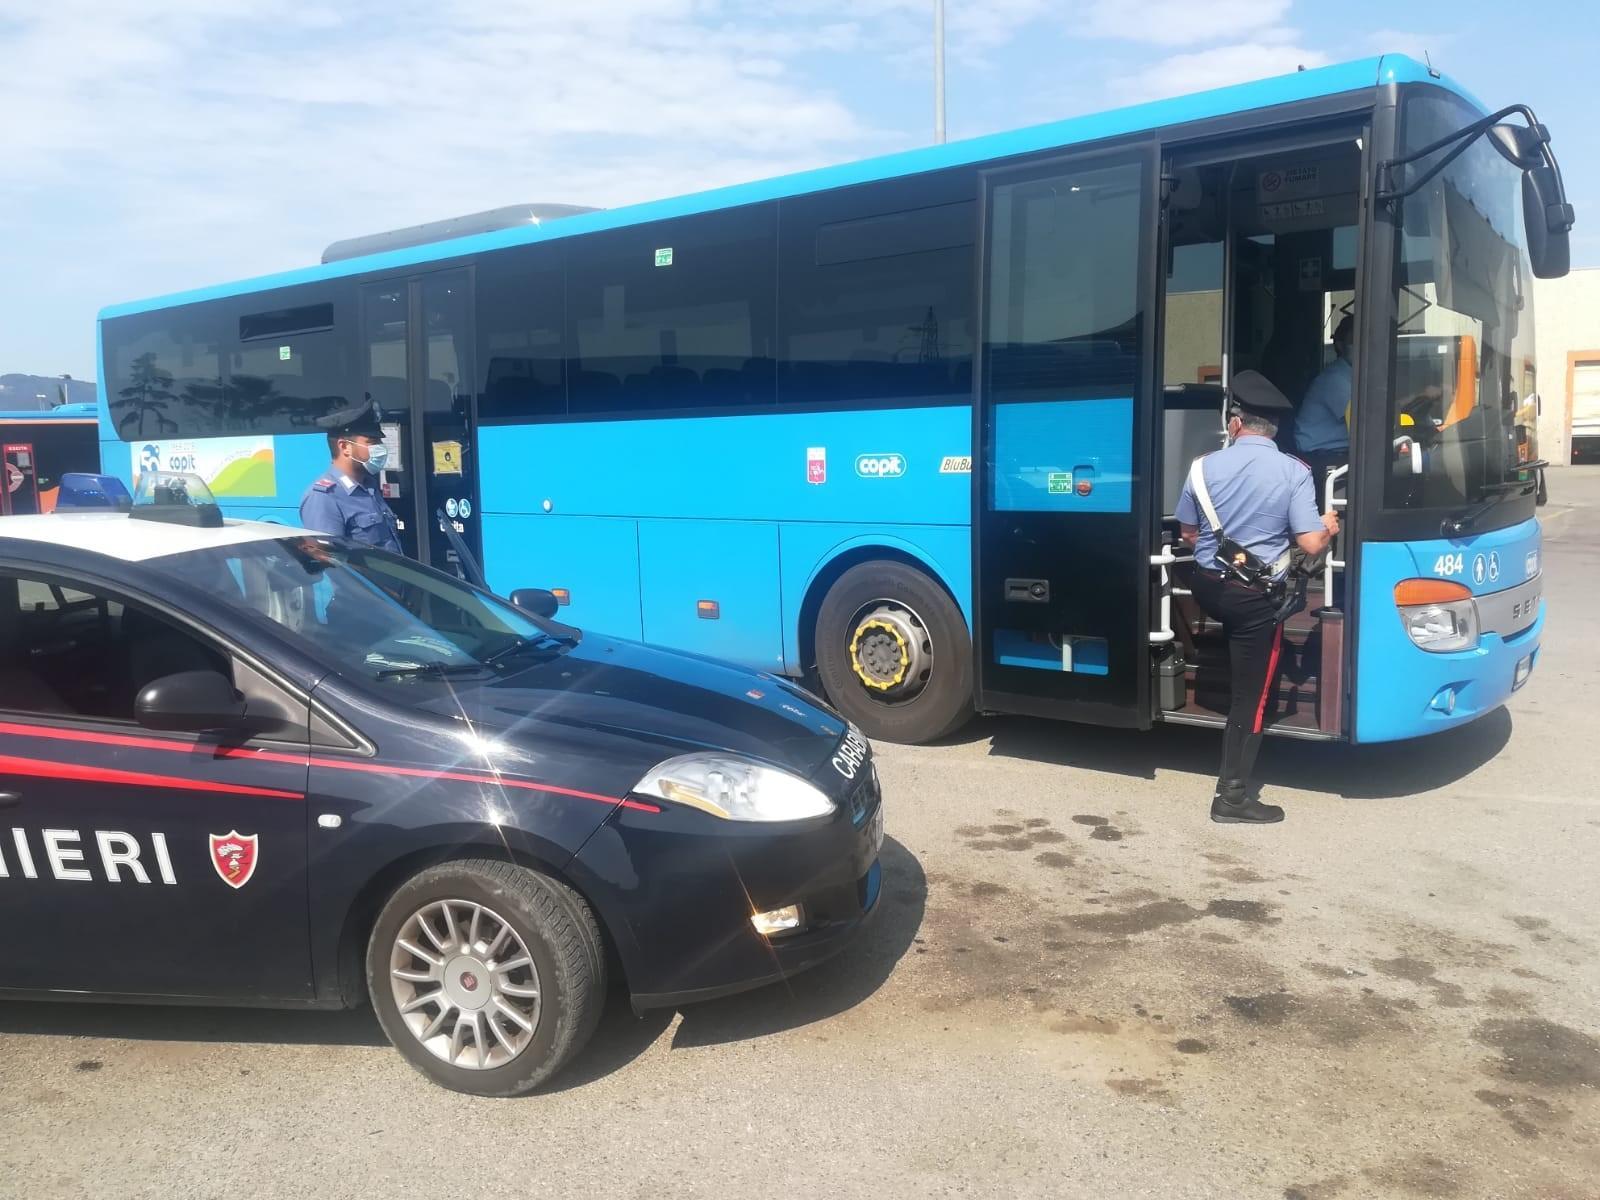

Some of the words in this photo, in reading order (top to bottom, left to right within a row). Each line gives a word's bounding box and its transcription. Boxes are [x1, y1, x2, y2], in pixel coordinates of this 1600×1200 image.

[859, 456, 902, 477] copit
[943, 458, 972, 471] BluBu
[1434, 553, 1464, 577] 484
[0, 827, 178, 885] IERI
